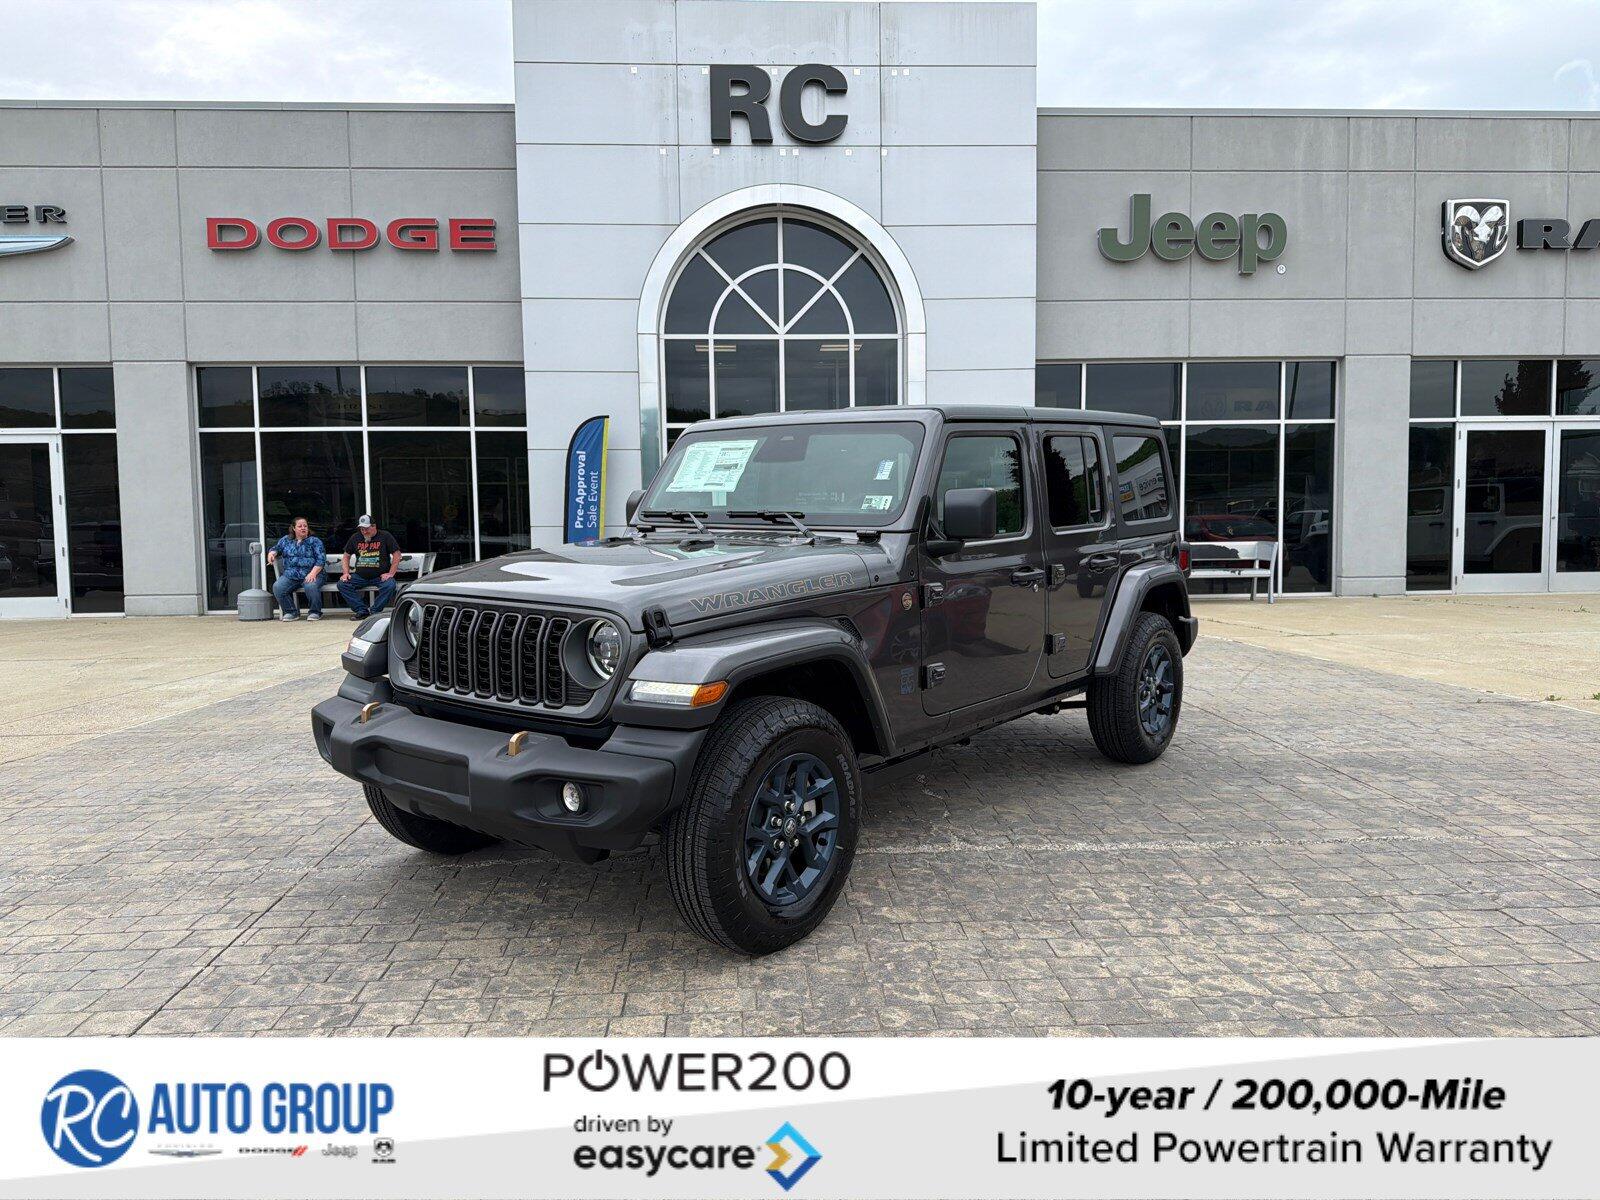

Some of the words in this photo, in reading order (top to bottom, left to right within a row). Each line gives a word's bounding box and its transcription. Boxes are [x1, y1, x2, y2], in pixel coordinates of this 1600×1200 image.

[709, 63, 849, 144] RC
[206, 217, 497, 252] DODGE
[1098, 193, 1288, 276] Jeep
[575, 450, 587, 529] Pre-Approval
[588, 470, 599, 502] Event
[587, 504, 597, 528] Sale
[688, 571, 856, 613] WRANGLER
